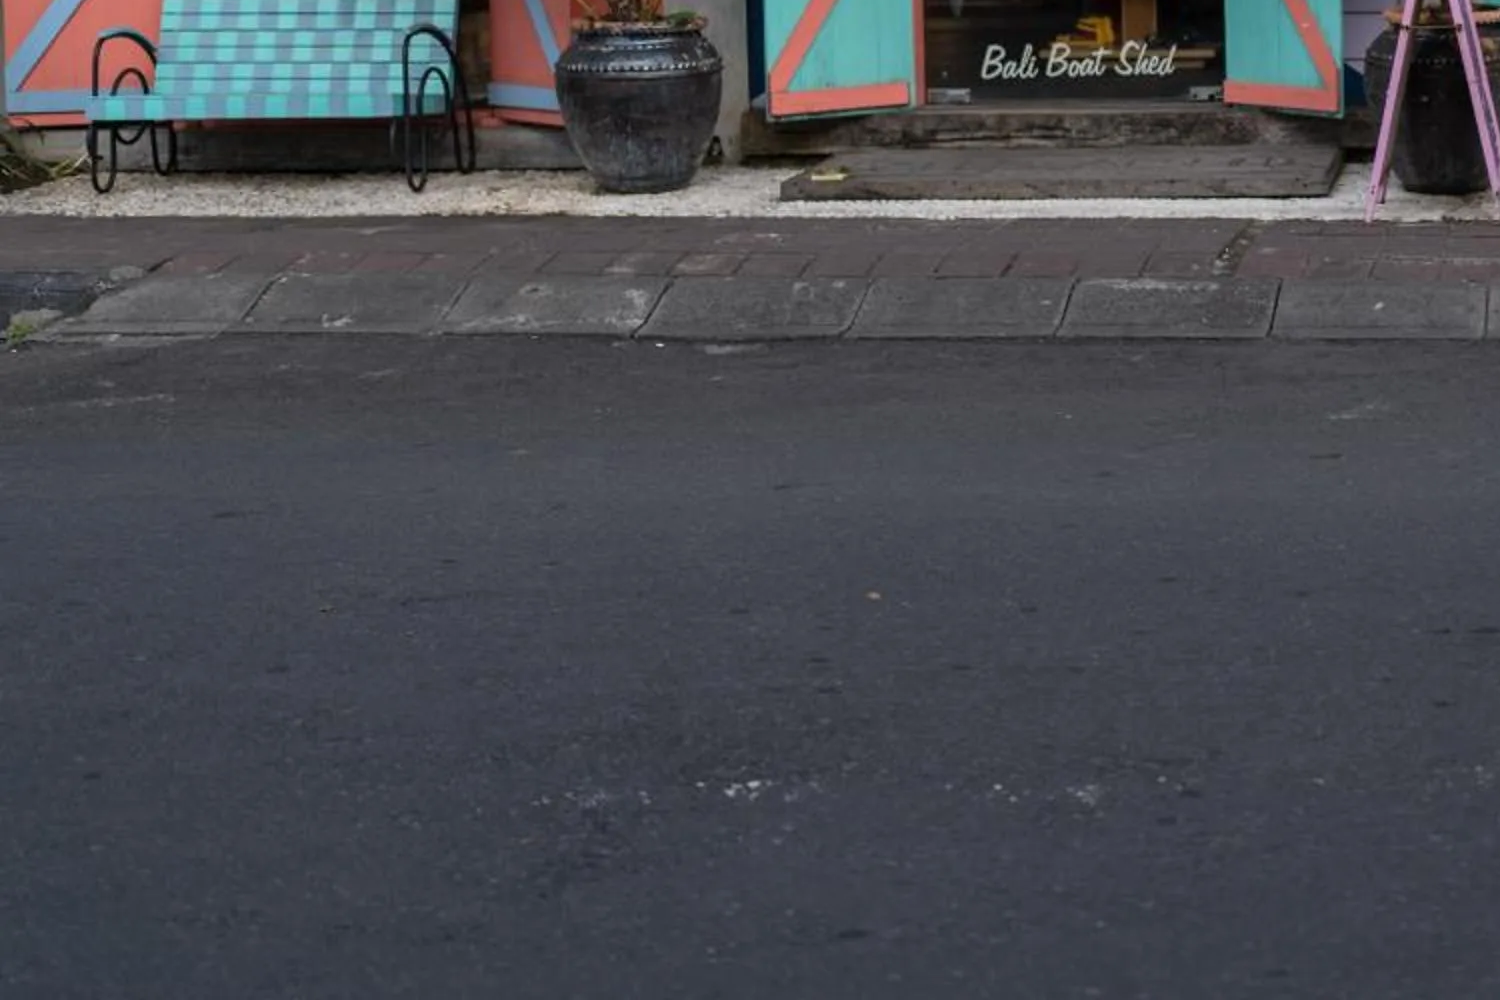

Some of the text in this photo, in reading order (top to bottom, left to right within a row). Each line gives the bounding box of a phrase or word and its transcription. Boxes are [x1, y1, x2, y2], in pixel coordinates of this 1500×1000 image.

[981, 40, 1177, 80] Bali Boat Shed
